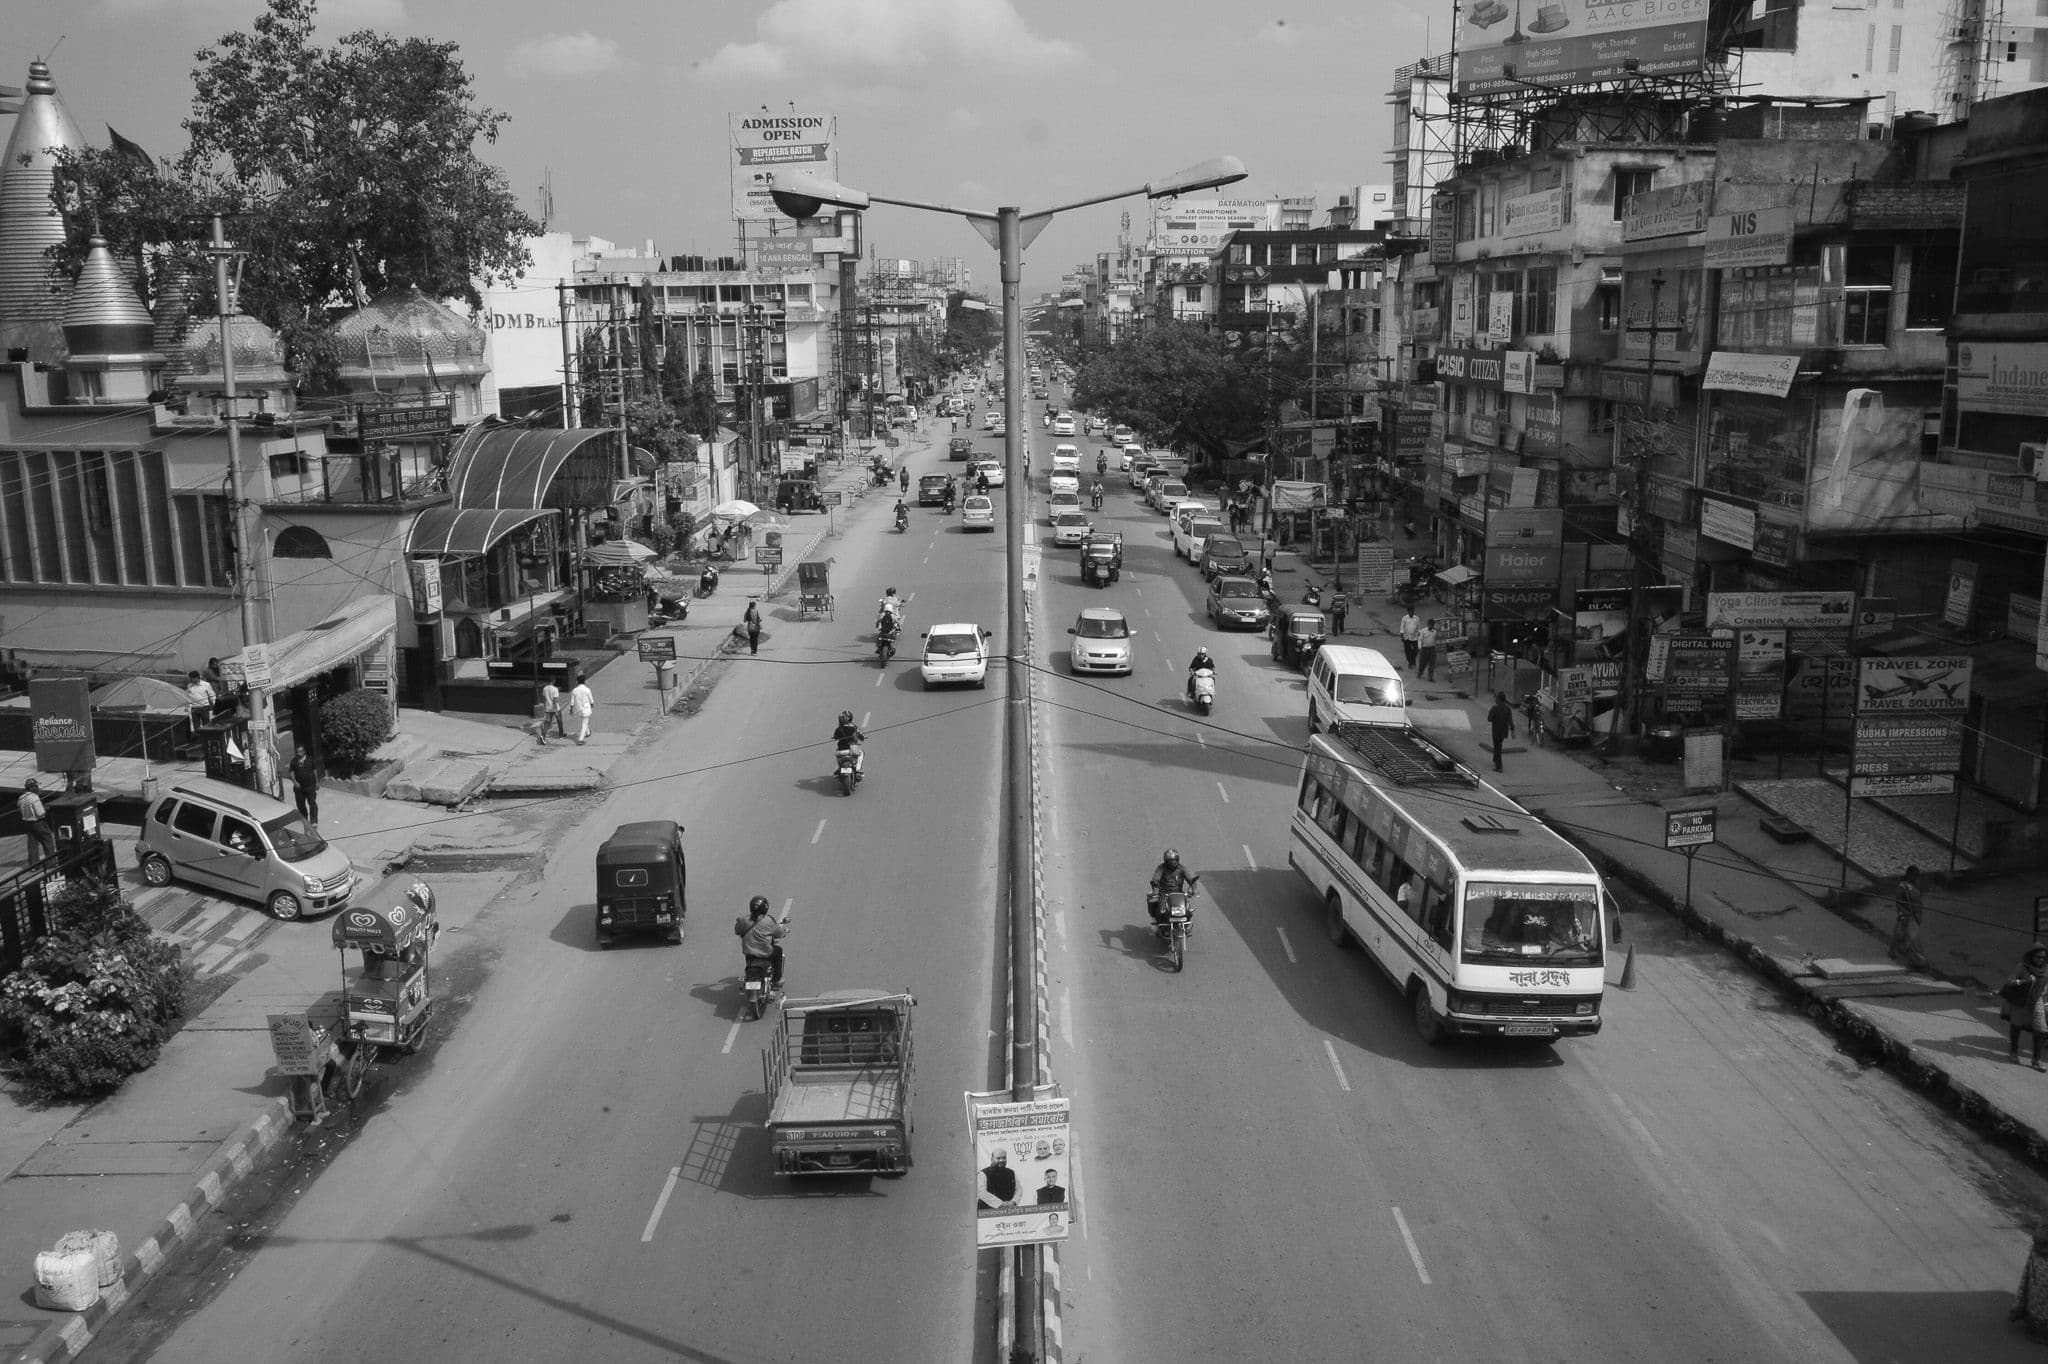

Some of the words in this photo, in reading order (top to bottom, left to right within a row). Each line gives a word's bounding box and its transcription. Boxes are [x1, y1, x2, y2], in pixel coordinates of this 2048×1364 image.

[1587, 4, 1633, 21] AAC
[1663, 41, 1696, 52] Resistant
[1592, 68, 1611, 78] email
[742, 117, 823, 129] ADMISSION
[763, 130, 802, 141] OPEN
[752, 147, 789, 157] REPEATERS
[790, 145, 813, 155] BATCH
[1730, 212, 1757, 236] NIS
[1155, 248, 1204, 256] DATAMATION
[493, 313, 535, 329] DMB
[1437, 354, 1465, 378] CASIO
[1469, 358, 1502, 381] CITIZEN
[1500, 553, 1546, 567] Haier
[1492, 593, 1552, 604] SHARP
[1712, 596, 1744, 608] Yoga
[1747, 595, 1778, 607] Clinic
[1734, 617, 1784, 625] Creative
[1787, 616, 1843, 626] Academy
[1671, 640, 1709, 649] DIGITAL
[1711, 640, 1732, 649] HUB
[1866, 660, 1923, 671] TRAVEL
[1927, 659, 1968, 670] ZONE
[1570, 672, 1585, 682] CITY
[1567, 680, 1588, 690] GENTS
[1863, 699, 1905, 709] TRAVEL
[1909, 698, 1965, 708] SOLUTION
[39, 716, 73, 726] Reliance
[33, 719, 87, 740] trends
[1856, 729, 1887, 739] SUBHA
[1889, 728, 1948, 738] IMPRESSIONS
[1855, 763, 1889, 773] PRESS
[1693, 816, 1703, 825] NO
[1682, 824, 1712, 835] PARKING
